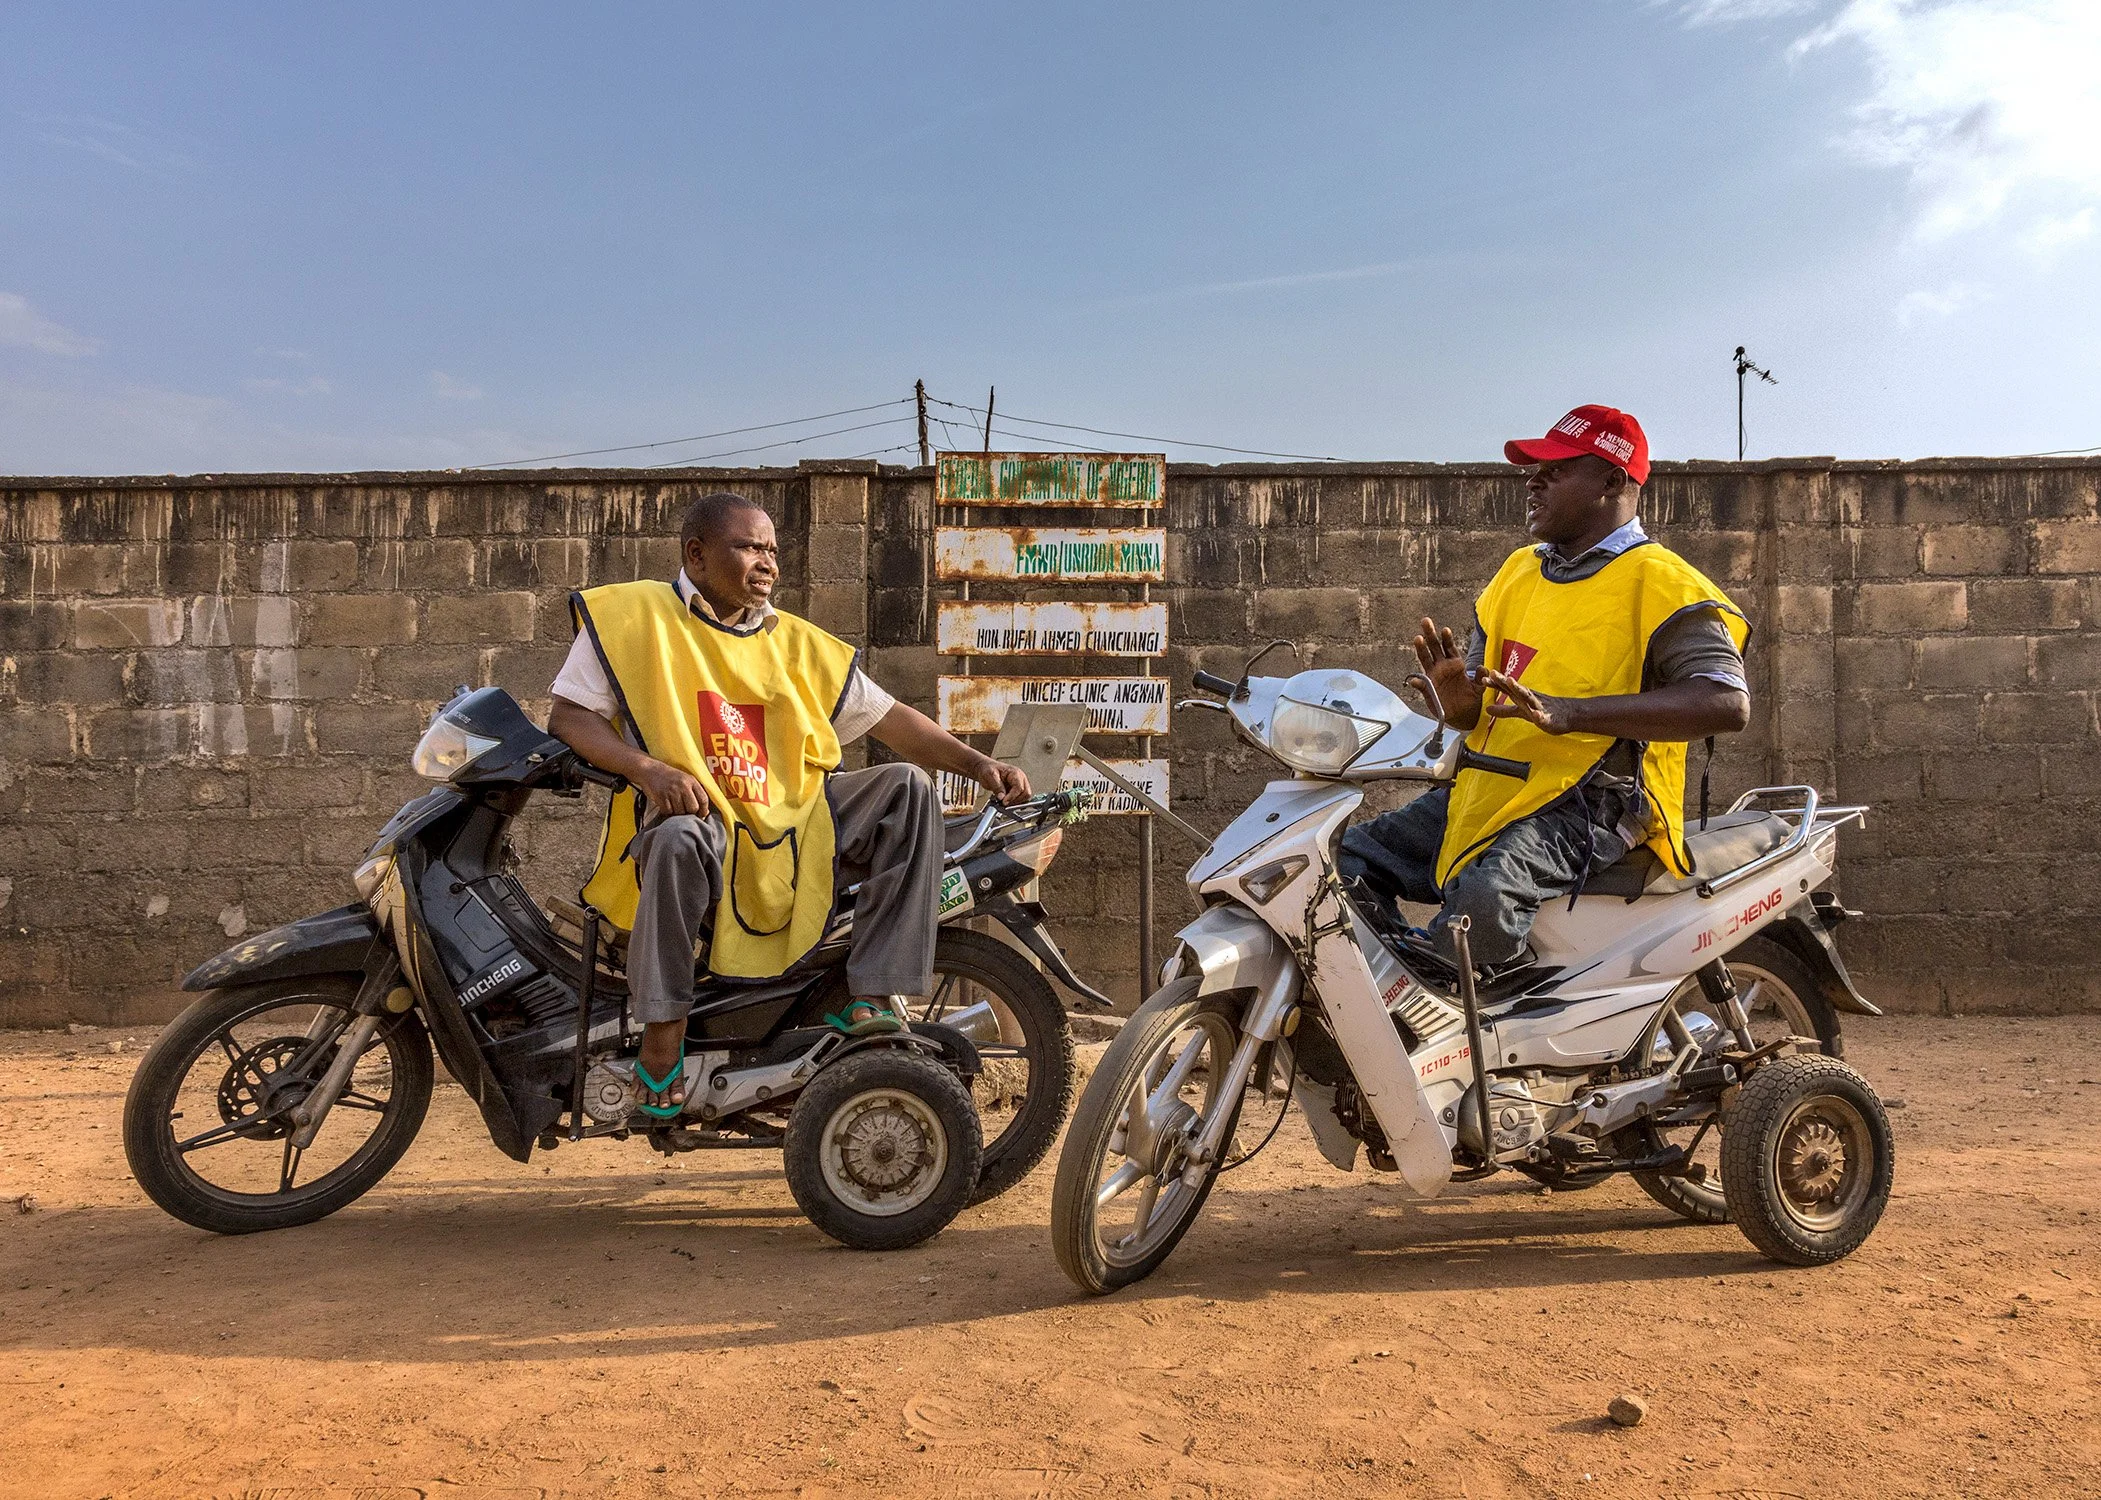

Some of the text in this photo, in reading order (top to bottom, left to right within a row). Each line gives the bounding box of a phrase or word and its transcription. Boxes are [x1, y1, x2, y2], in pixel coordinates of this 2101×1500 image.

[1572, 420, 1592, 439] 2019
[1605, 432, 1635, 455] MEMBER
[1086, 461, 1102, 500] OF
[1107, 461, 1156, 501] NIGERIA
[1120, 542, 1160, 573] MINNA
[1040, 630, 1081, 651] AHMED
[1085, 630, 1160, 652] CHANCHANGI
[1022, 681, 1066, 703] UNICEF
[1069, 682, 1110, 703] CLINIC
[1086, 708, 1129, 729] DUNA.
[710, 733, 759, 763] END
[706, 755, 767, 784] POLIO
[717, 774, 765, 802] NOW
[457, 958, 522, 1007] JINCHENG
[1381, 974, 1410, 1008] CHENG
